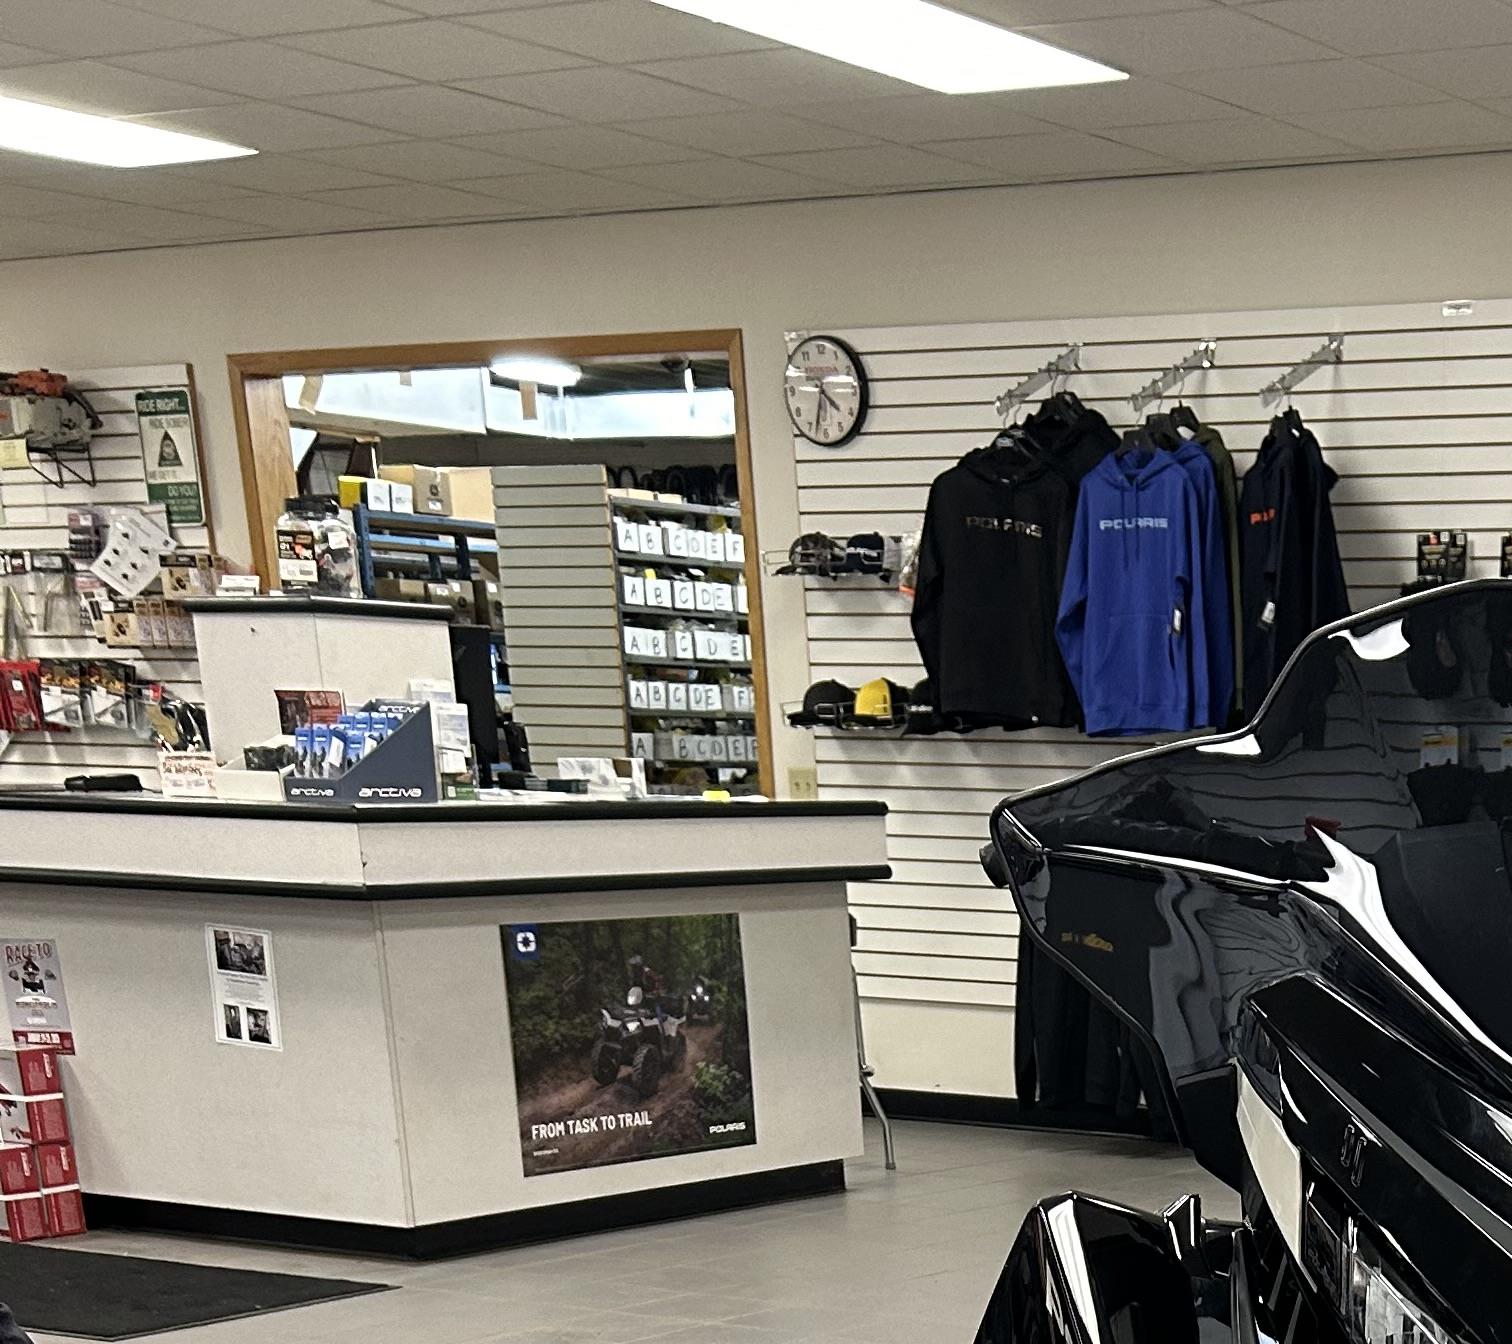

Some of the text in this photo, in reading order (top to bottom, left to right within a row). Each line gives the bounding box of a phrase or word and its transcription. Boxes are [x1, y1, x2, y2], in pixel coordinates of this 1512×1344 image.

[816, 344, 826, 354] 12
[801, 351, 810, 361] 11
[789, 385, 796, 397] 9
[795, 406, 802, 418] 8
[837, 421, 844, 432] 5
[823, 428, 830, 439] 6
[966, 516, 1043, 539] POLARIS
[1100, 517, 1169, 530] POLARIS
[290, 786, 335, 797] arctiva
[358, 787, 422, 798] arctiva
[5, 942, 52, 964] RACE TO
[531, 1110, 653, 1141] FROM TASK TO TRAIL
[709, 1121, 746, 1135] POLARIS
